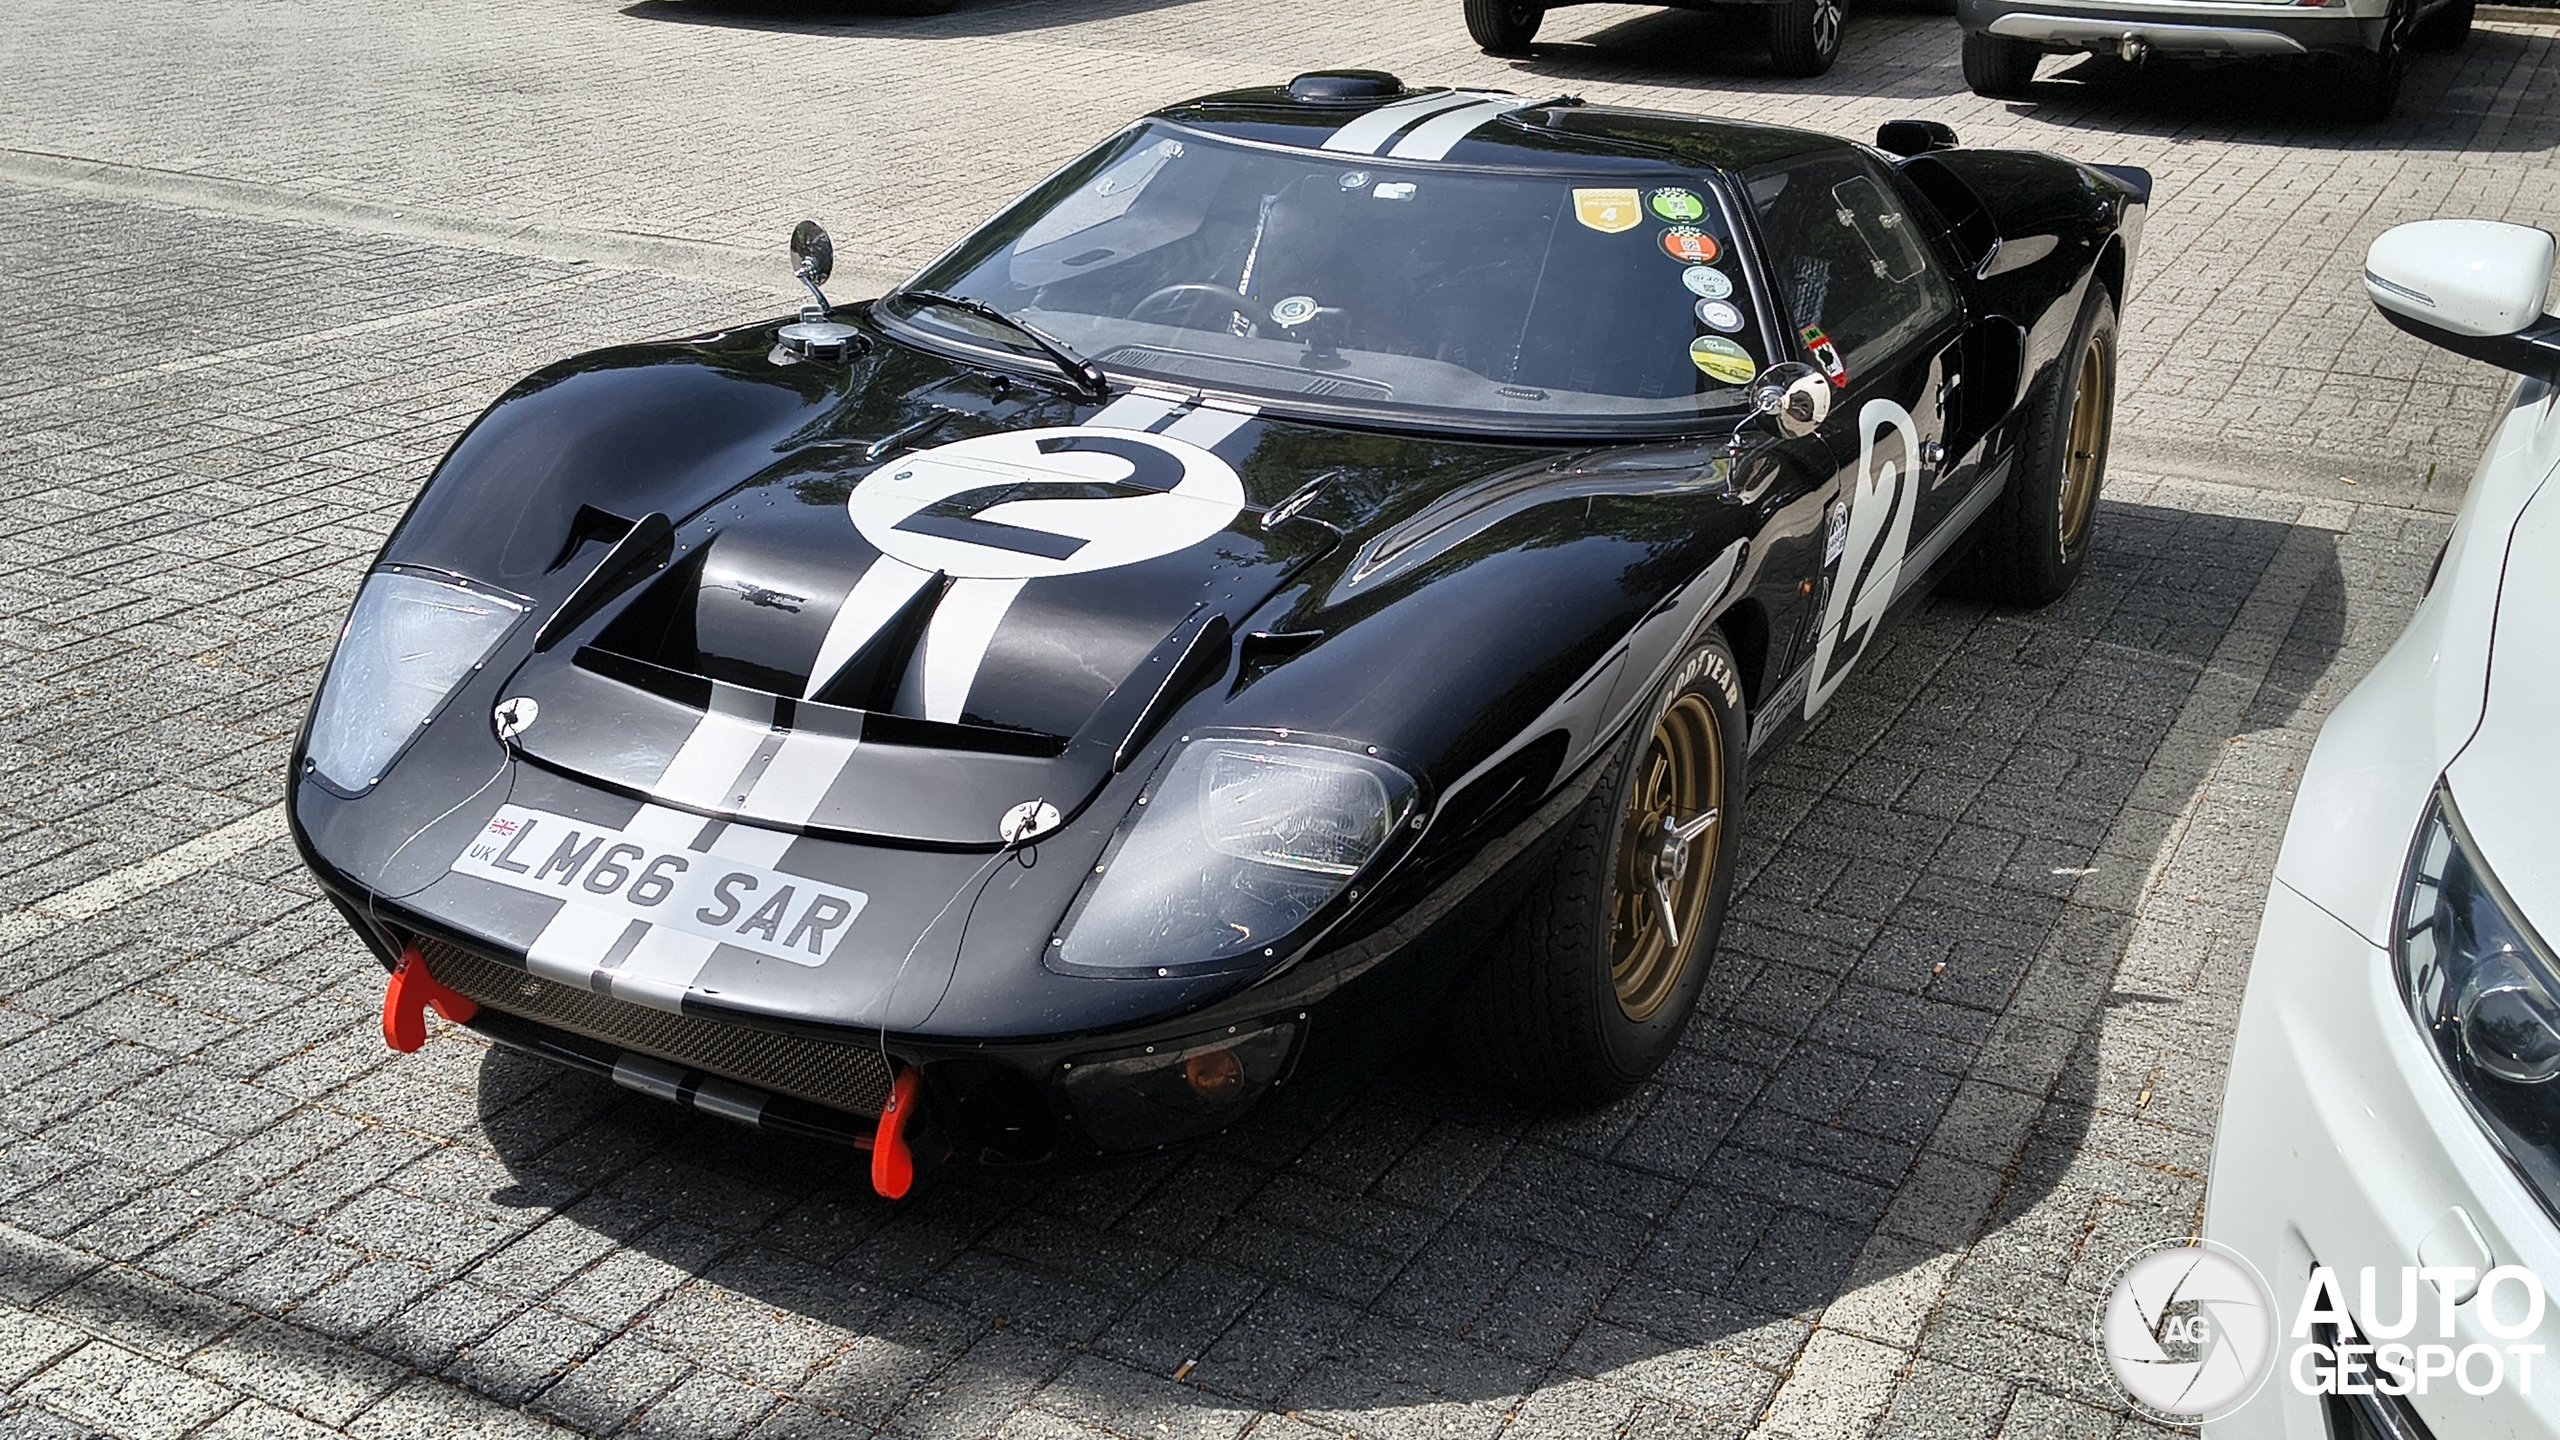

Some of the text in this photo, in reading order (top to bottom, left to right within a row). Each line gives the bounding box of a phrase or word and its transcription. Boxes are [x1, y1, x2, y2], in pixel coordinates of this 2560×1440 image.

[1599, 207, 1618, 222] 4
[891, 435, 1186, 561] 2
[1816, 420, 1906, 694] 2
[469, 843, 495, 863] UK
[491, 819, 852, 956] LM66 SAR
